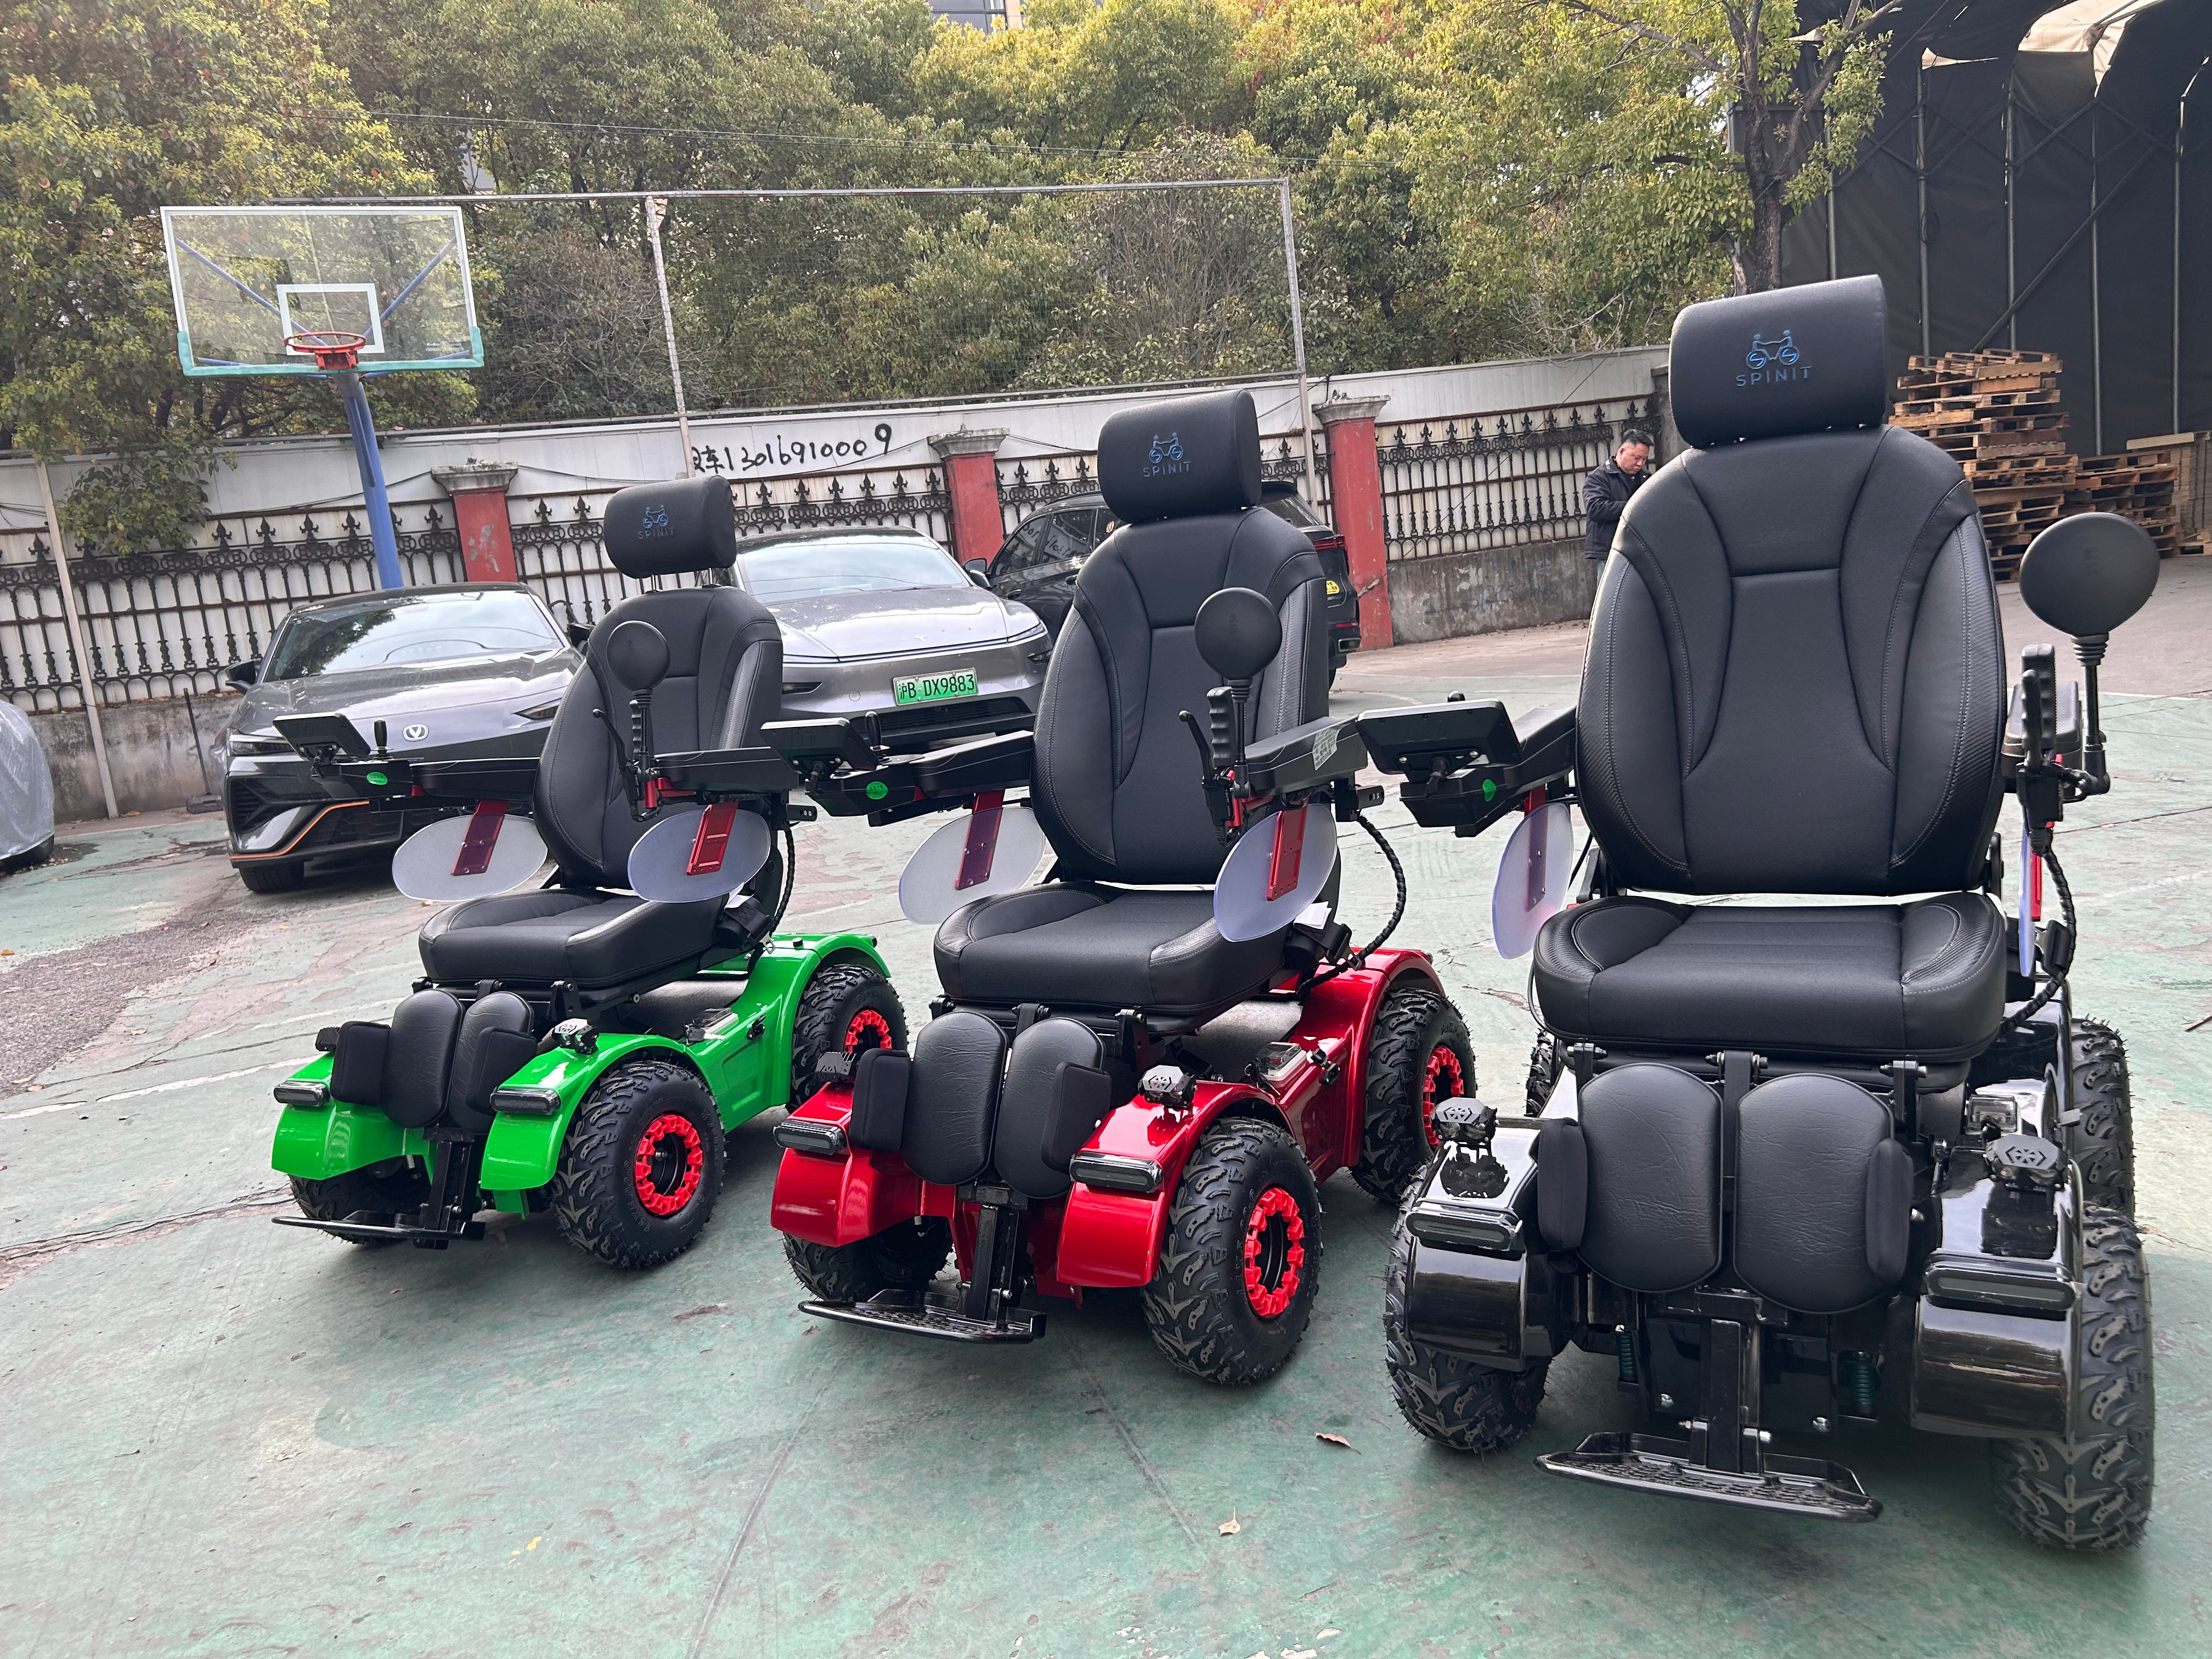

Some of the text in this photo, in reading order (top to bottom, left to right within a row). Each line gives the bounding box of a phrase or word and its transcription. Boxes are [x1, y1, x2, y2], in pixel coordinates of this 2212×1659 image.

[1736, 365, 1812, 387] SPINIT
[1143, 461, 1191, 477] SPINIT
[637, 527, 675, 539] SPINIT
